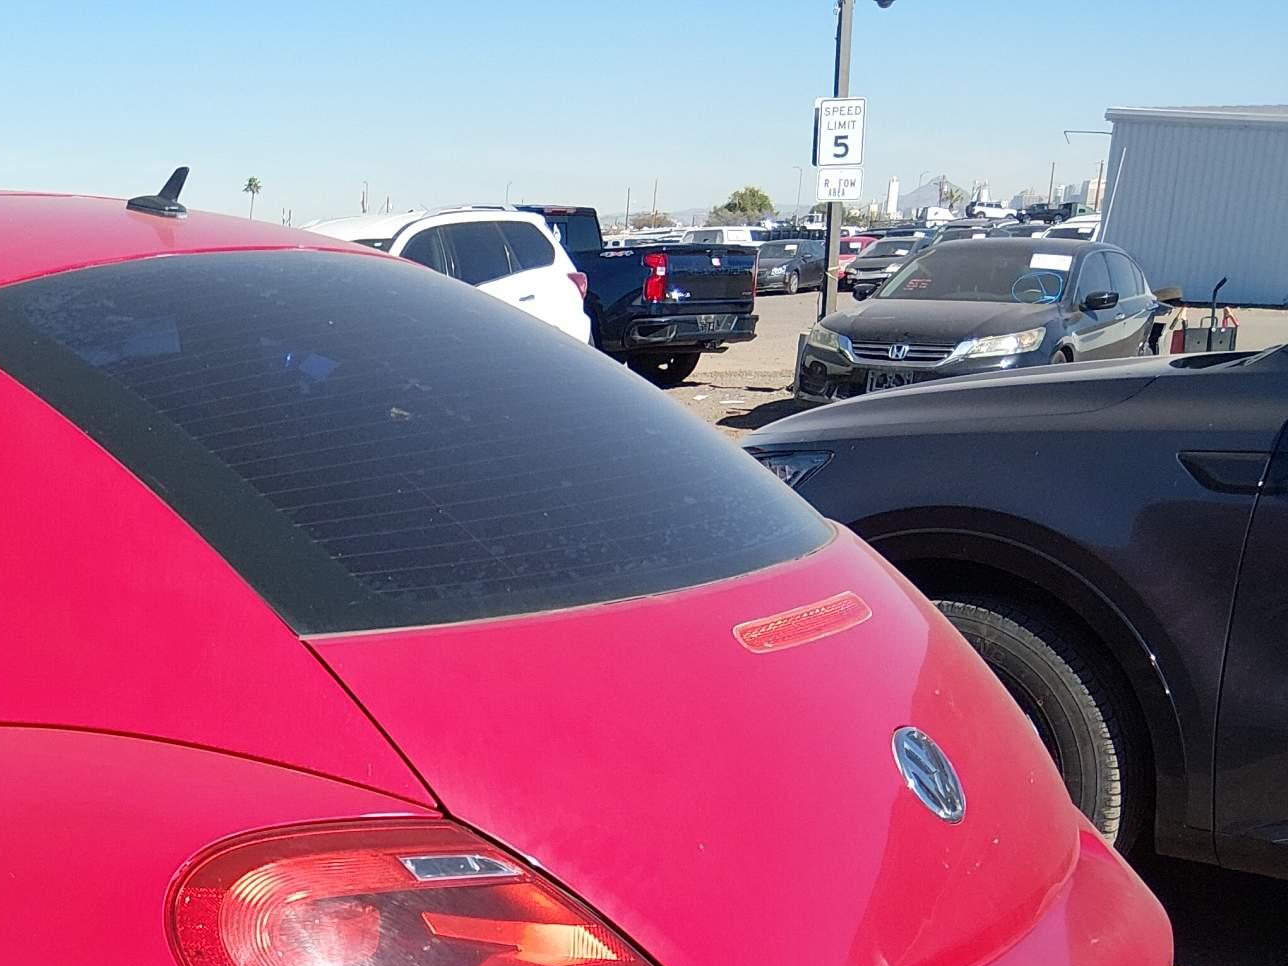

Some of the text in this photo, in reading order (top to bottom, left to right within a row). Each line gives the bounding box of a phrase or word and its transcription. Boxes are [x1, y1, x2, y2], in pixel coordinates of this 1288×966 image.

[824, 106, 862, 116] SPEED
[827, 120, 857, 130] LIMIT
[833, 135, 849, 158] 5
